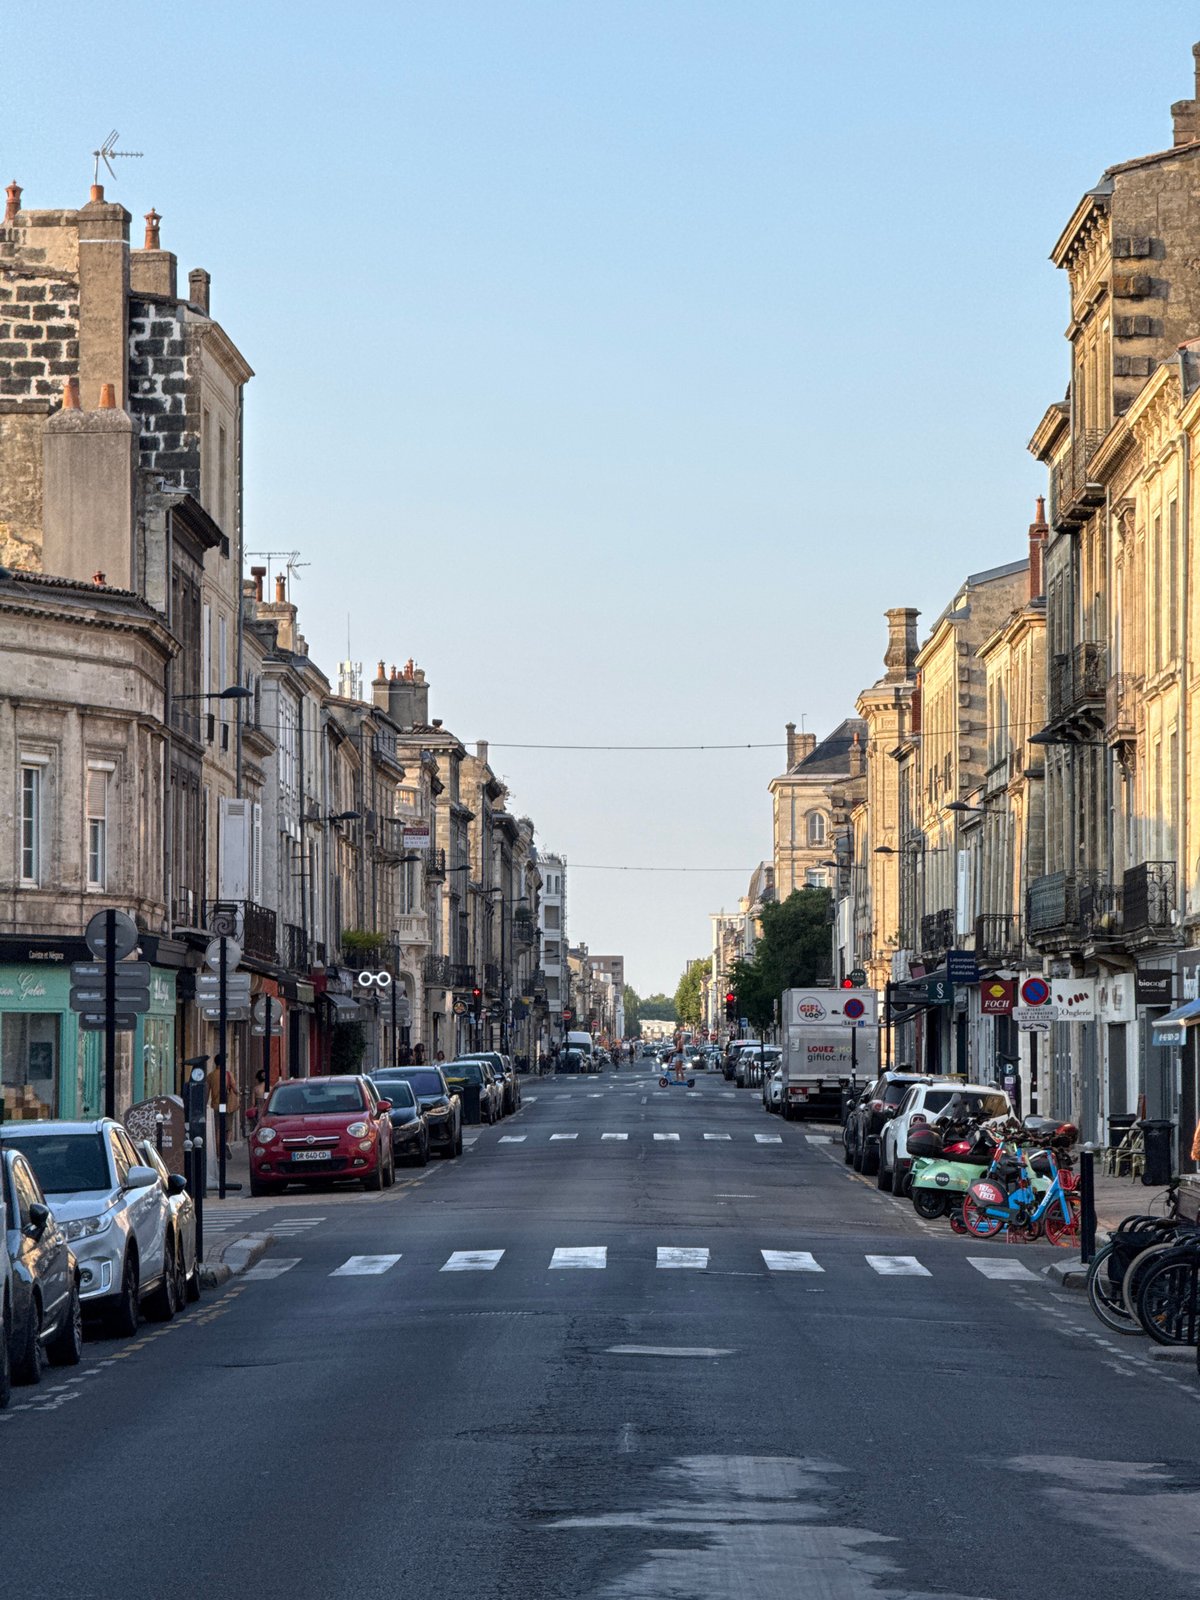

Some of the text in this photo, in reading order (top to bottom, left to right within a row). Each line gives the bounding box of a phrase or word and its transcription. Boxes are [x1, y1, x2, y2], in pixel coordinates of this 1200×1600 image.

[984, 1000, 1010, 1008] FOCH
[1060, 1007, 1091, 1017] 'Onglerie
[807, 1053, 847, 1063] gifiloc.fr
[1006, 1064, 1014, 1074] P
